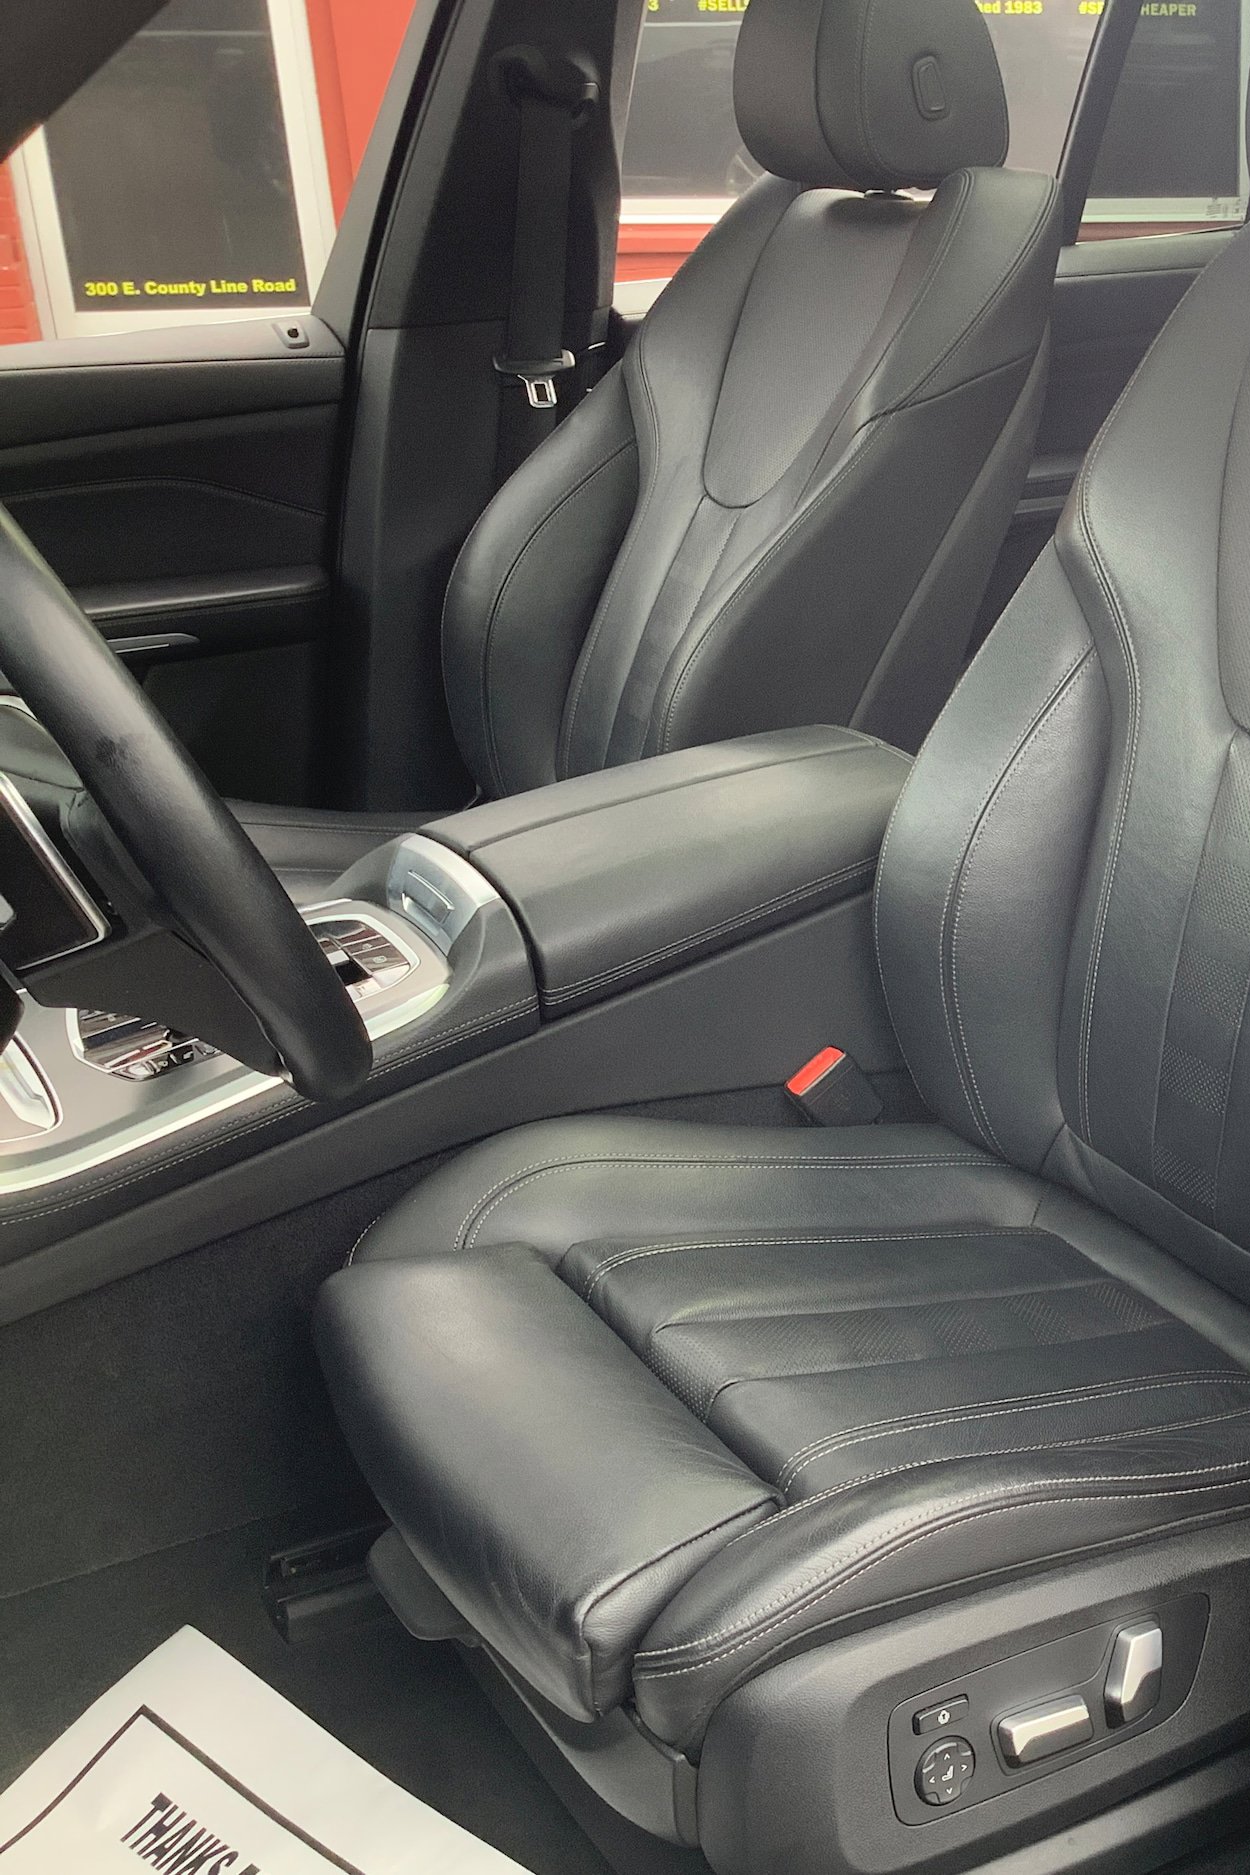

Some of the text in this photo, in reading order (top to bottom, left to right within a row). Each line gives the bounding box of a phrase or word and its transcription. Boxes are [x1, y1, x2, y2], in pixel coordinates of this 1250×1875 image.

[697, 0, 749, 11] #SELL
[1004, 0, 1043, 14] 1983
[1140, 3, 1197, 16] HEAPER
[84, 278, 296, 297] 300 E. County Line Road
